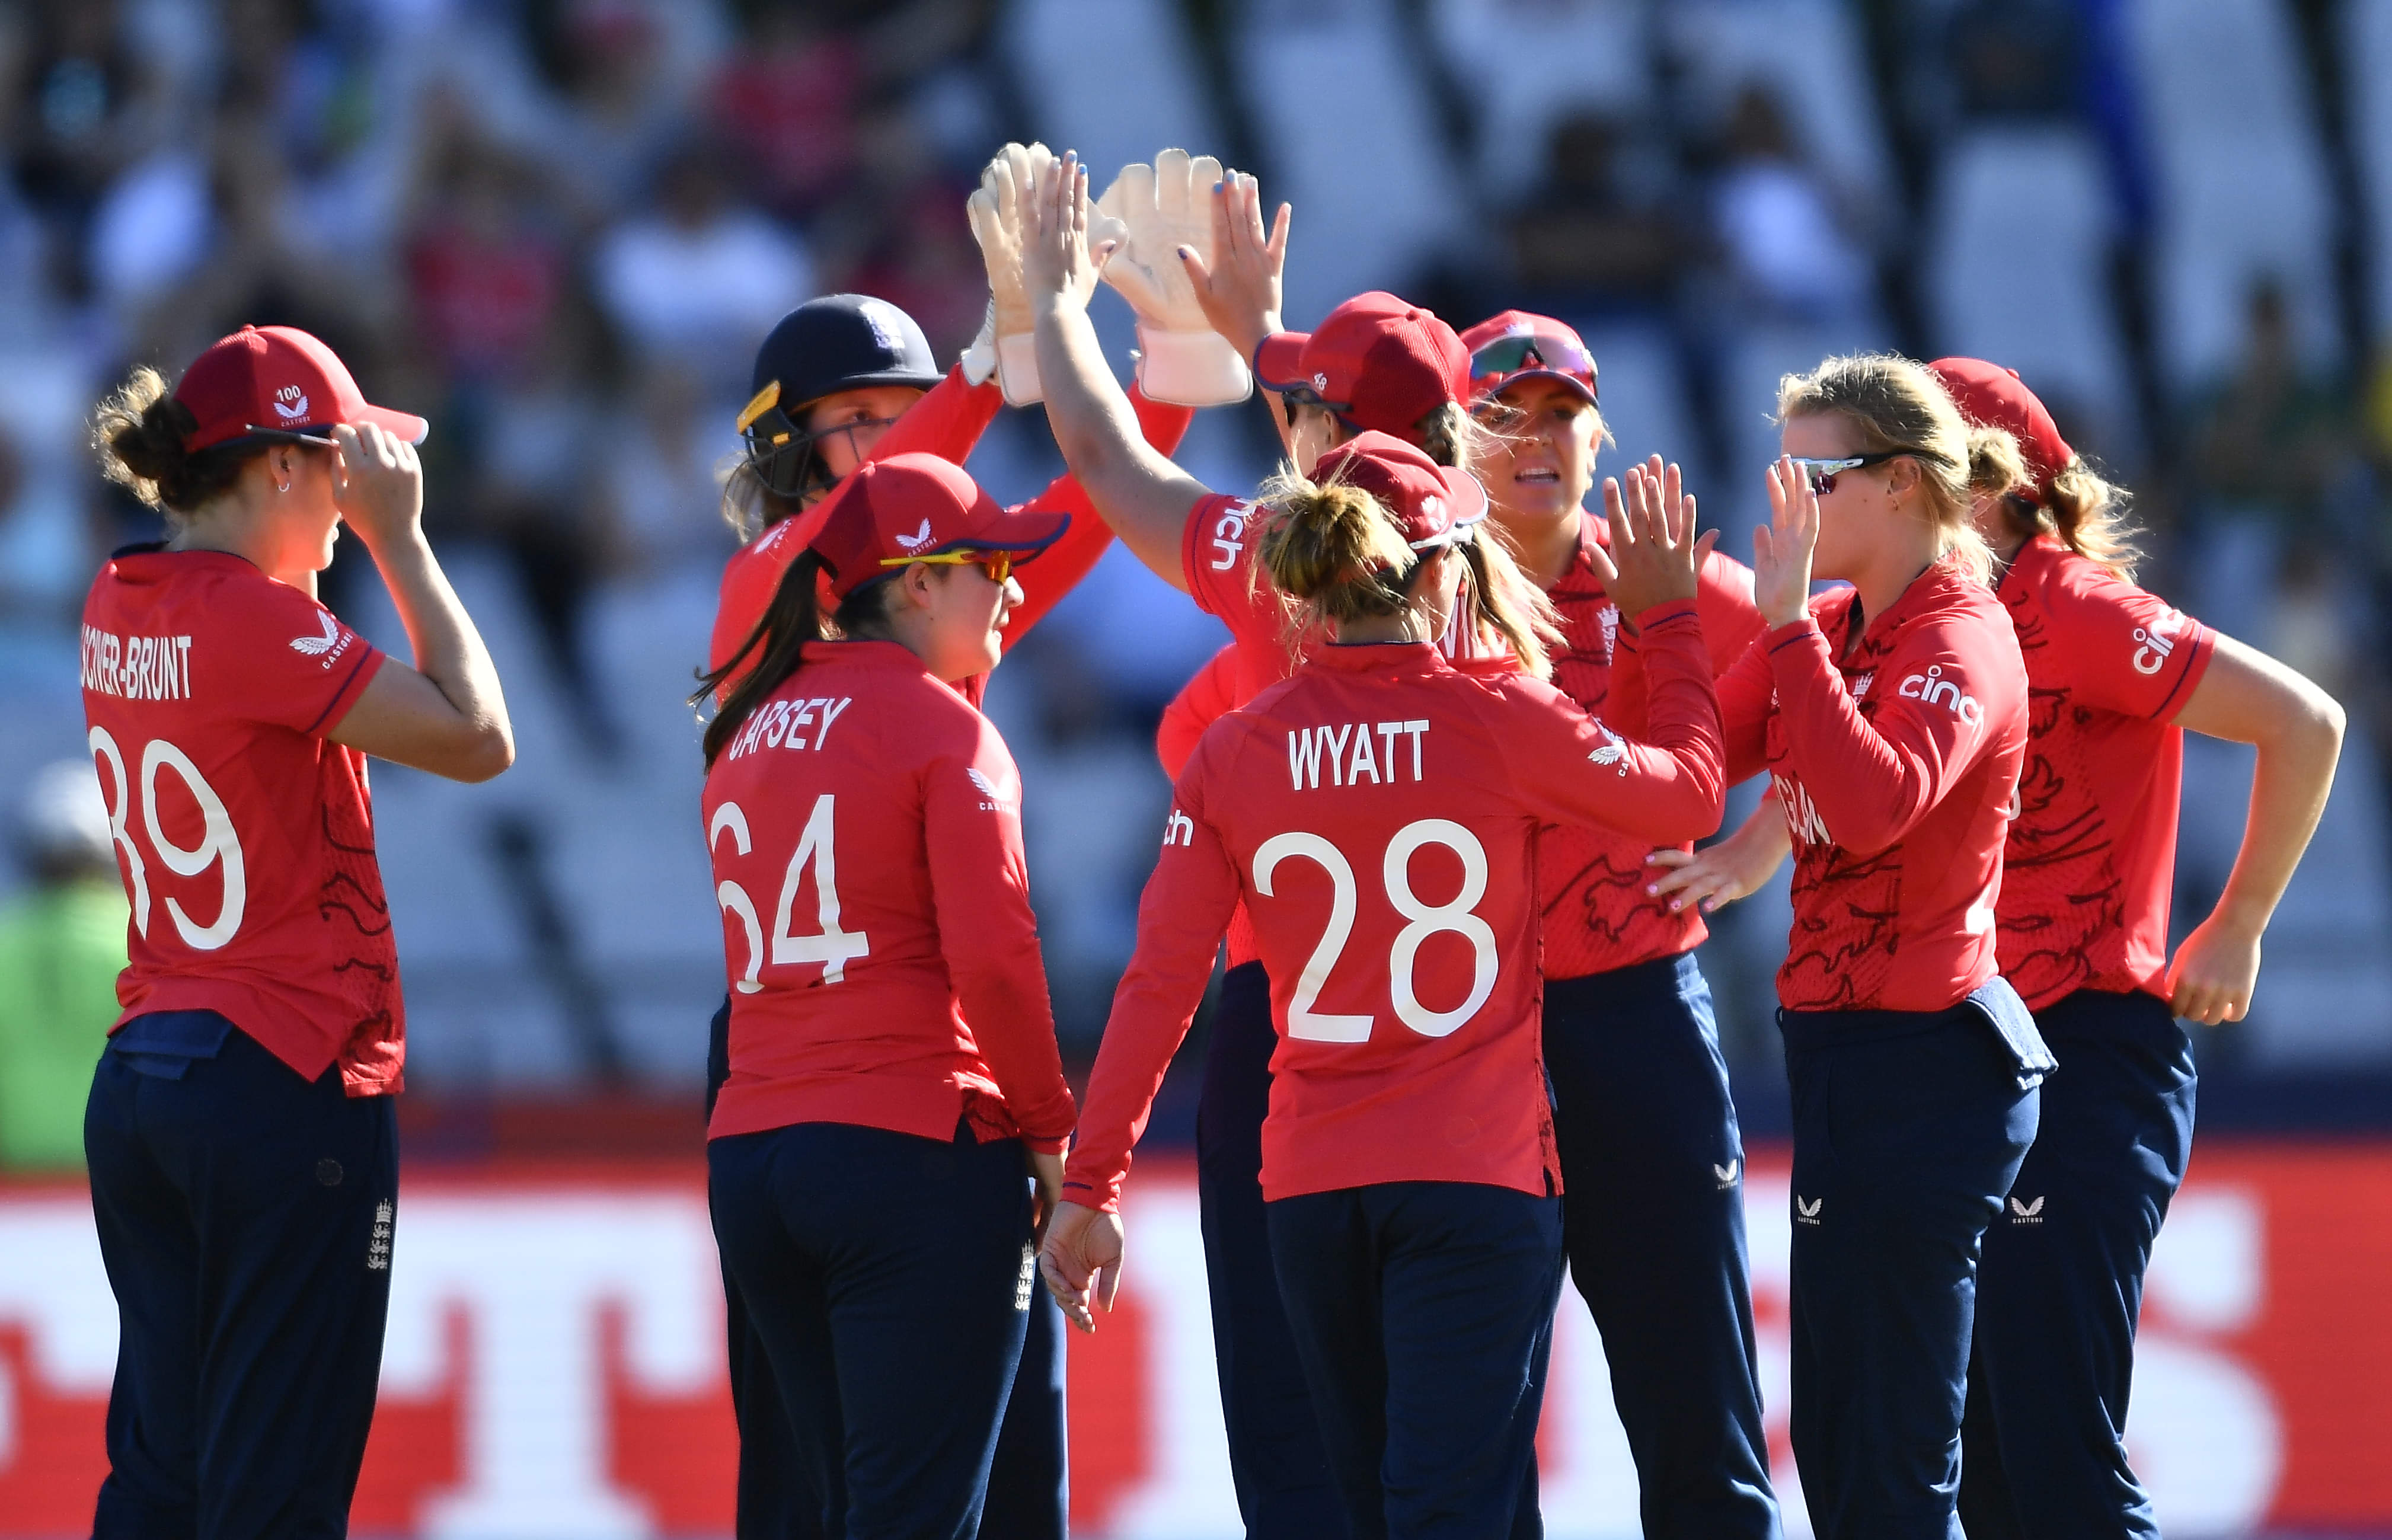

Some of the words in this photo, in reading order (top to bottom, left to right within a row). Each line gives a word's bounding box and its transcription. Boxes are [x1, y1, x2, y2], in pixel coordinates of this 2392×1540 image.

[276, 385, 301, 402] 100
[729, 697, 852, 761] CAPSEY
[1288, 719, 1430, 791] WYATT
[90, 726, 245, 950] 39
[711, 794, 870, 993] 64
[1252, 819, 1499, 1043] 28
